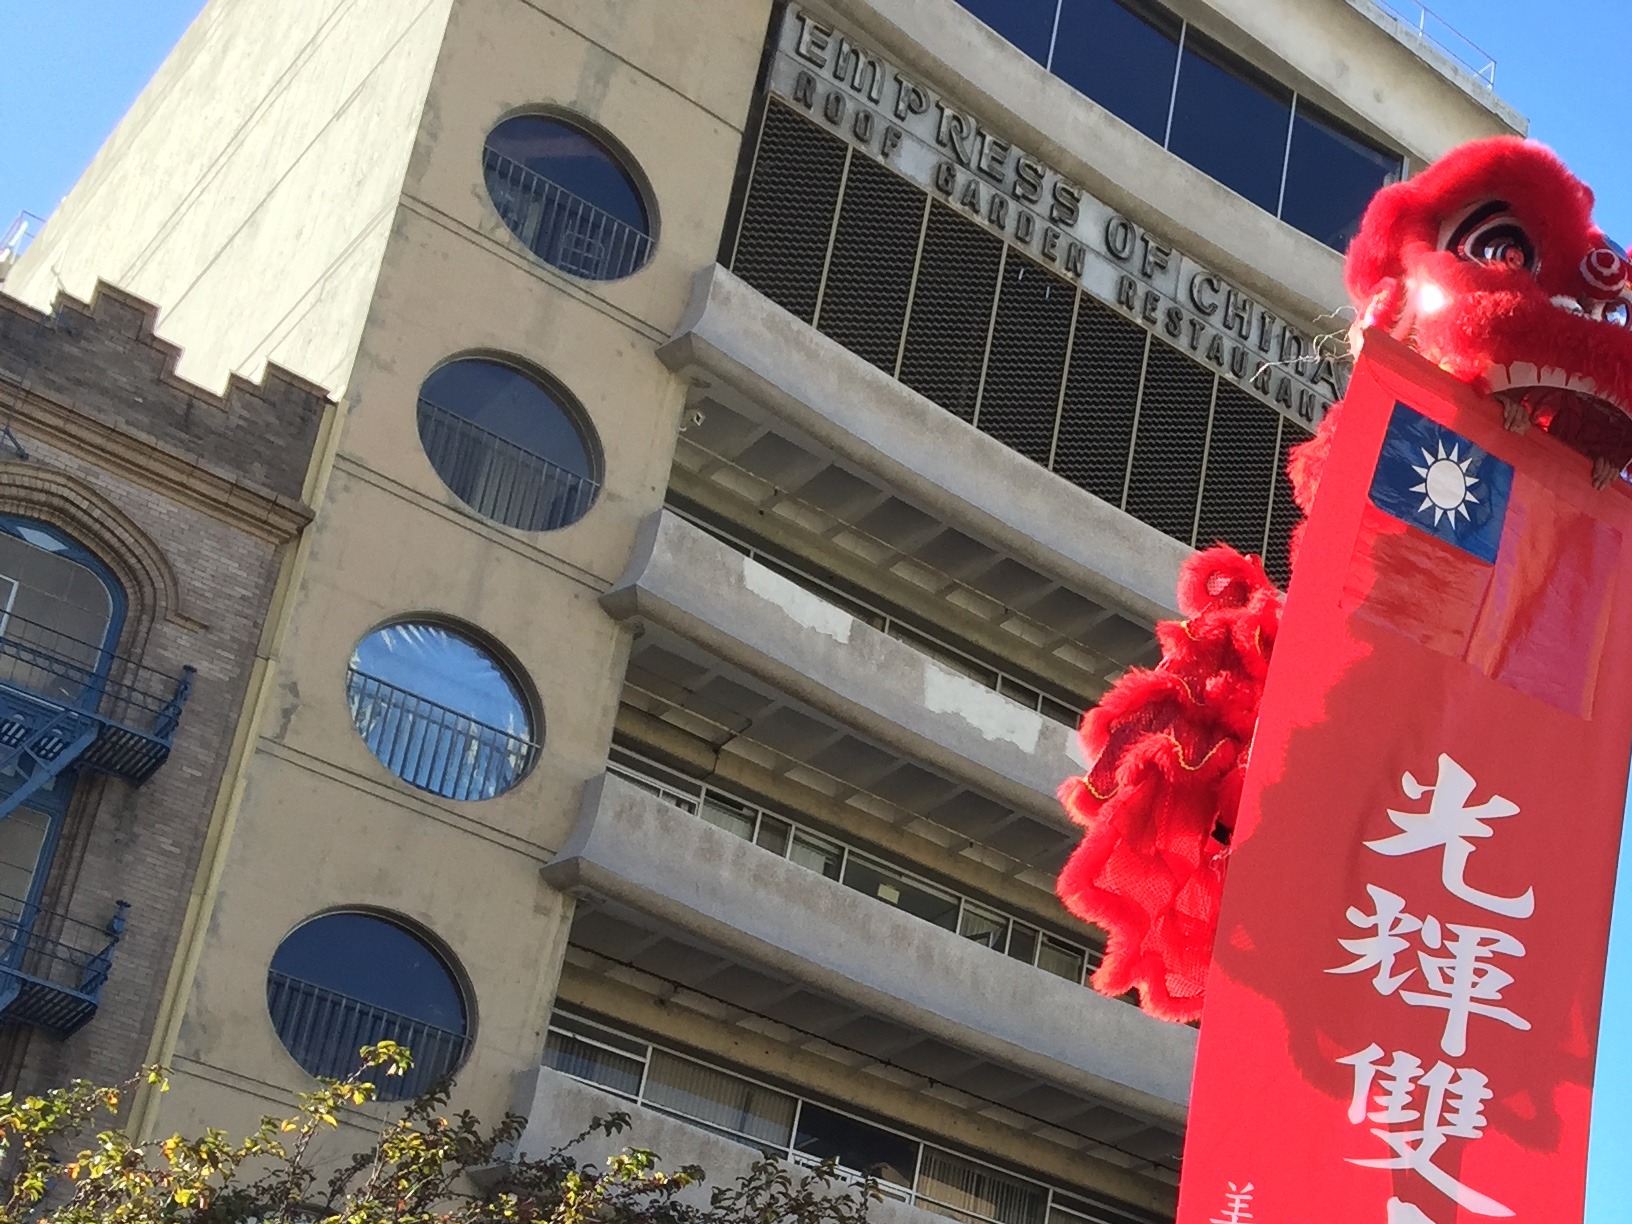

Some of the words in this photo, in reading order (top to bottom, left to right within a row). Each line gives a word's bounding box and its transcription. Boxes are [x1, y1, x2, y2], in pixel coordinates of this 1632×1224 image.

[793, 69, 902, 158] ROOF
[934, 160, 1087, 277] GARDEN
[1117, 273, 1330, 424] RESTAURAN
[795, 12, 1084, 228] EMPRESS
[1105, 215, 1173, 279] OF
[1189, 270, 1347, 402] CHINA
